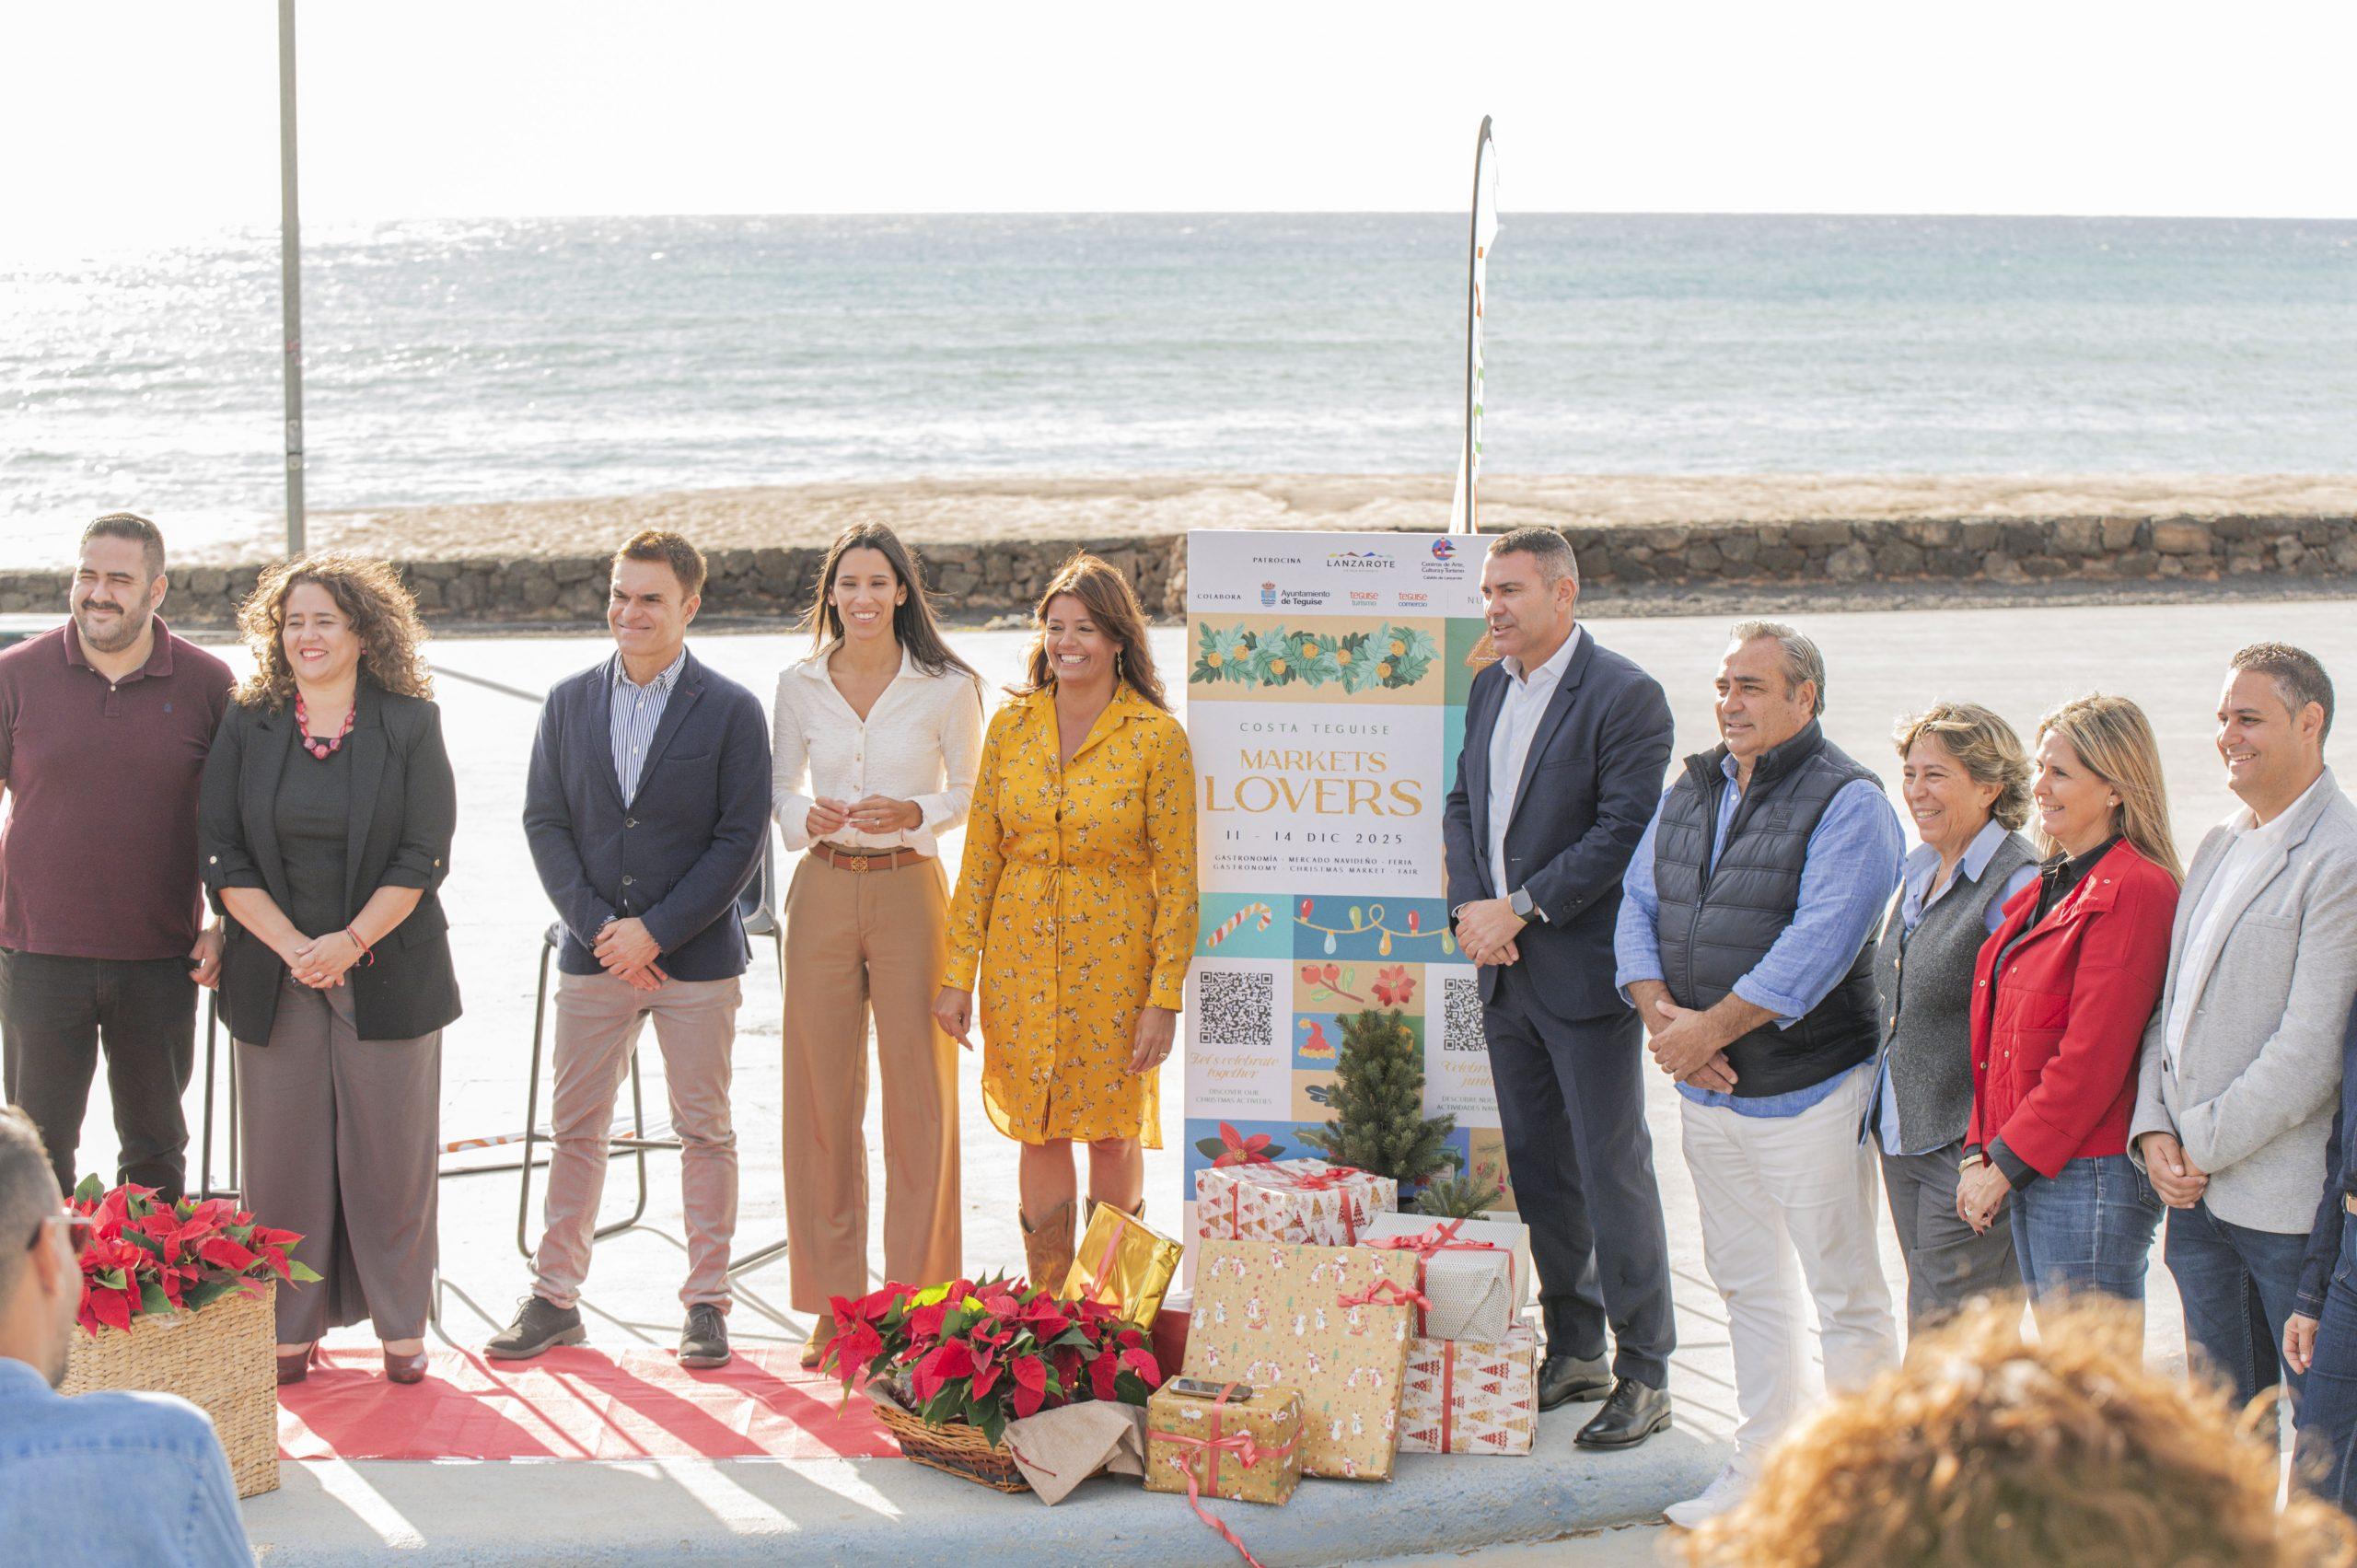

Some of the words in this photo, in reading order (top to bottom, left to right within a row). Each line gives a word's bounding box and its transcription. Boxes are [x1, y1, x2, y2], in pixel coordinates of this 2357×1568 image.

[1327, 560, 1395, 568] LANZAROTE
[1281, 589, 1330, 598] Ayuntamiento
[1239, 722, 1298, 734] COSTA
[1311, 724, 1390, 736] TEGUISE
[1239, 749, 1387, 773] MARKETS
[1204, 775, 1422, 817] LOVERS
[1225, 830, 1240, 841] 11
[1273, 830, 1292, 842] 14
[1306, 832, 1341, 843] DIC
[1355, 832, 1402, 844] 2025
[1334, 856, 1377, 865] NAVIDEÑO
[1222, 1052, 1279, 1066] celebrate
[1207, 1067, 1258, 1081] together
[1195, 1096, 1235, 1104] CHRISTMAS
[1237, 1097, 1272, 1105] ACTIVITIES
